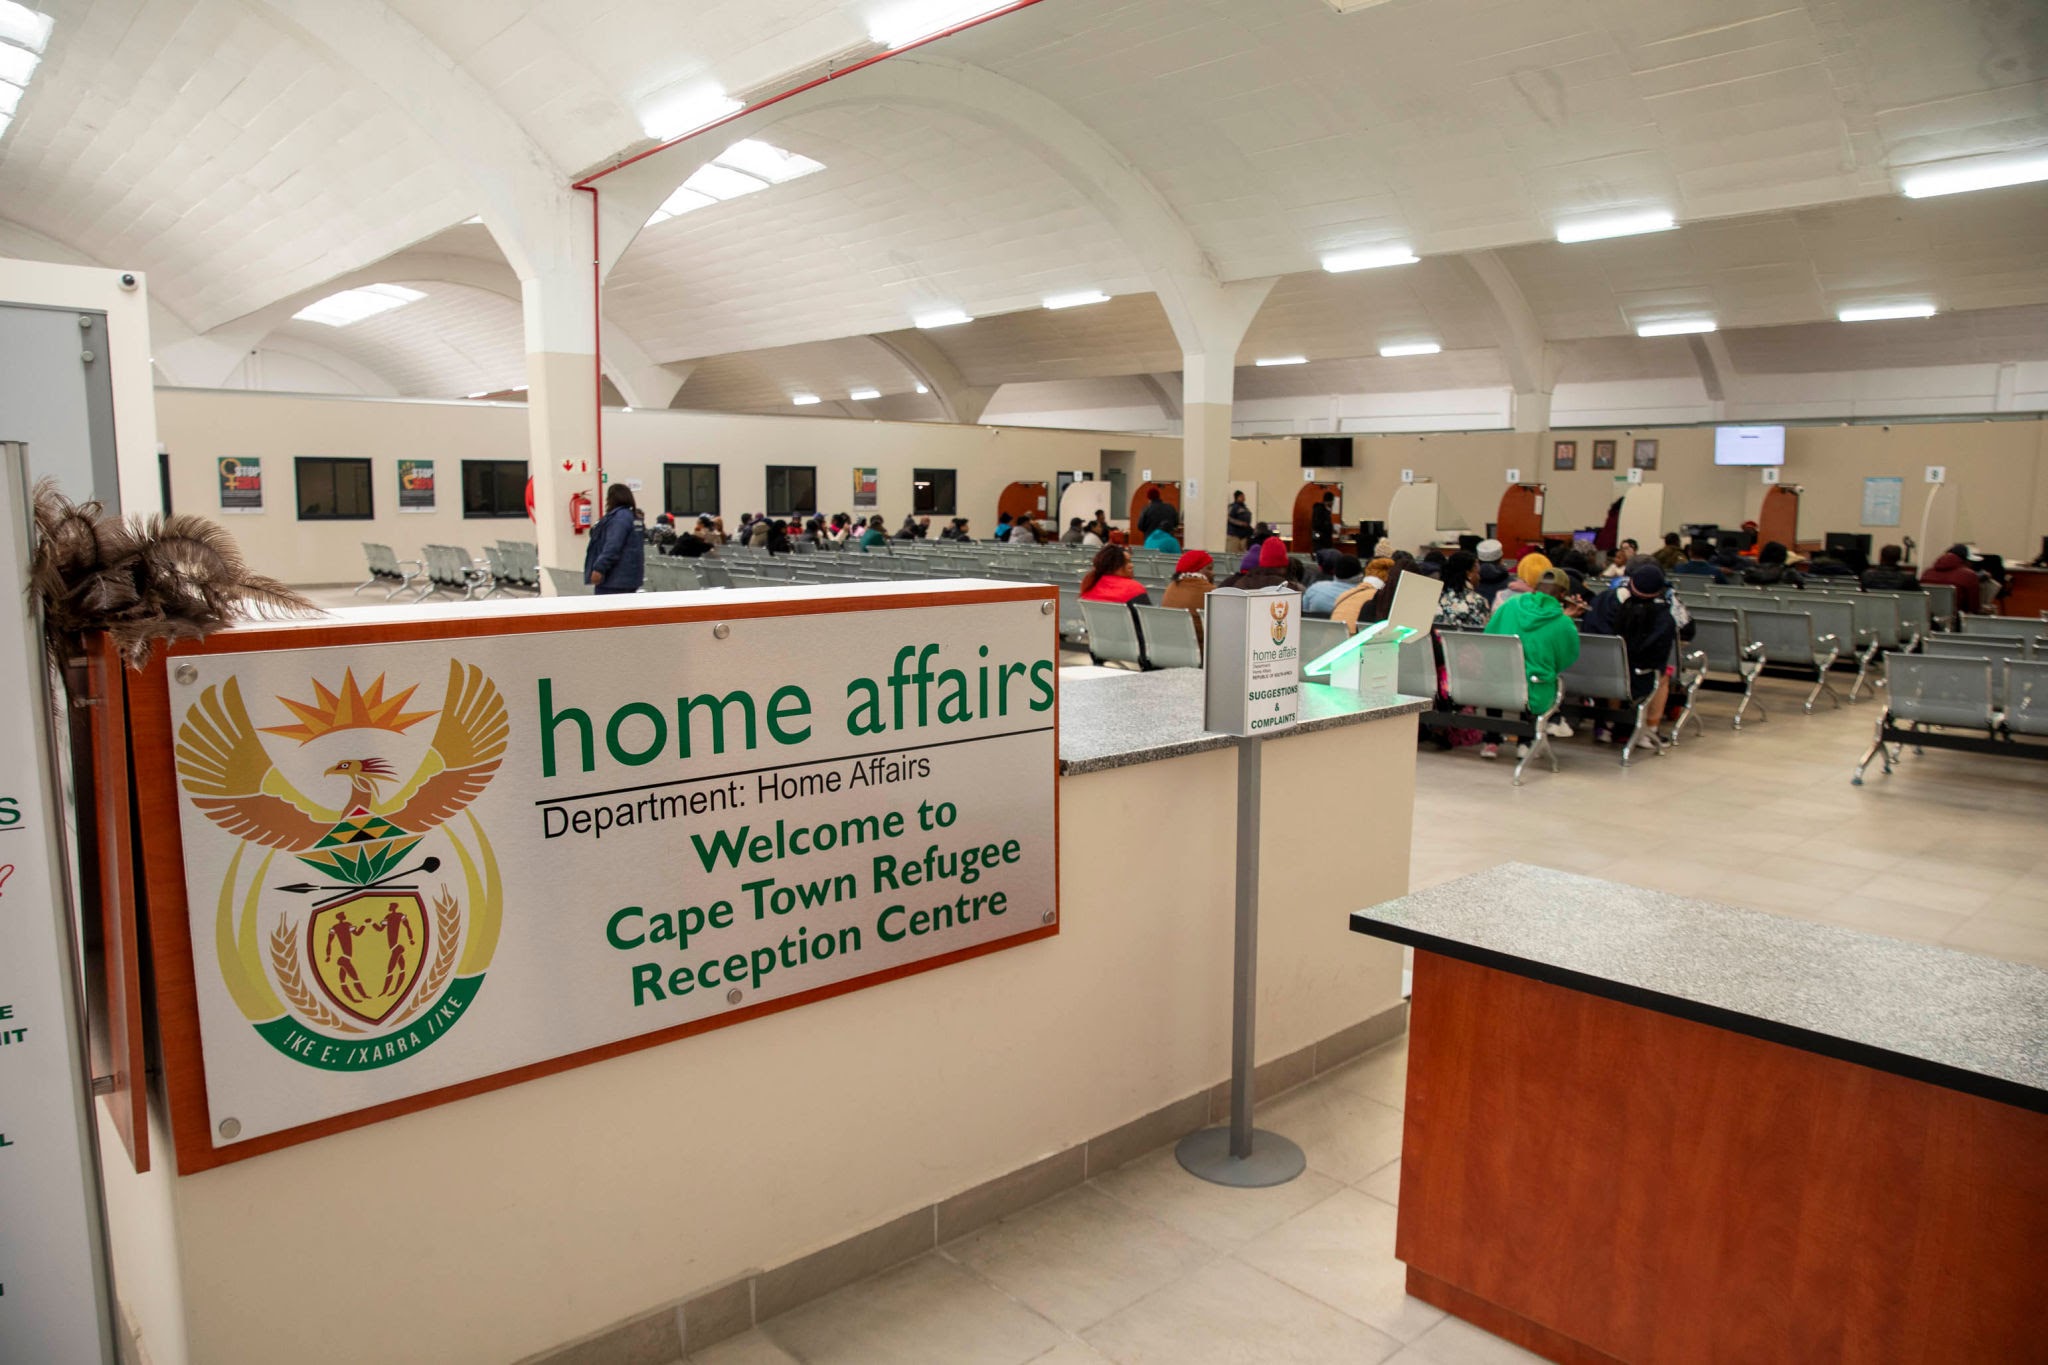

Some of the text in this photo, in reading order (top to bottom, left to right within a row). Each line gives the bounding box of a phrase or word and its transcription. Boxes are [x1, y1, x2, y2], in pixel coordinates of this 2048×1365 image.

[1253, 646, 1297, 661] home affairs
[538, 643, 1055, 778] home affairs
[1249, 684, 1298, 701] SUGGESTIONS
[1251, 713, 1296, 729] COMPLAINTS
[1274, 702, 1280, 711] &
[543, 754, 931, 839] Department: Home Affairs
[690, 800, 957, 873] Welcome to
[606, 839, 1021, 950] Cape Town Refugee
[632, 891, 1008, 1007] Reception Centre
